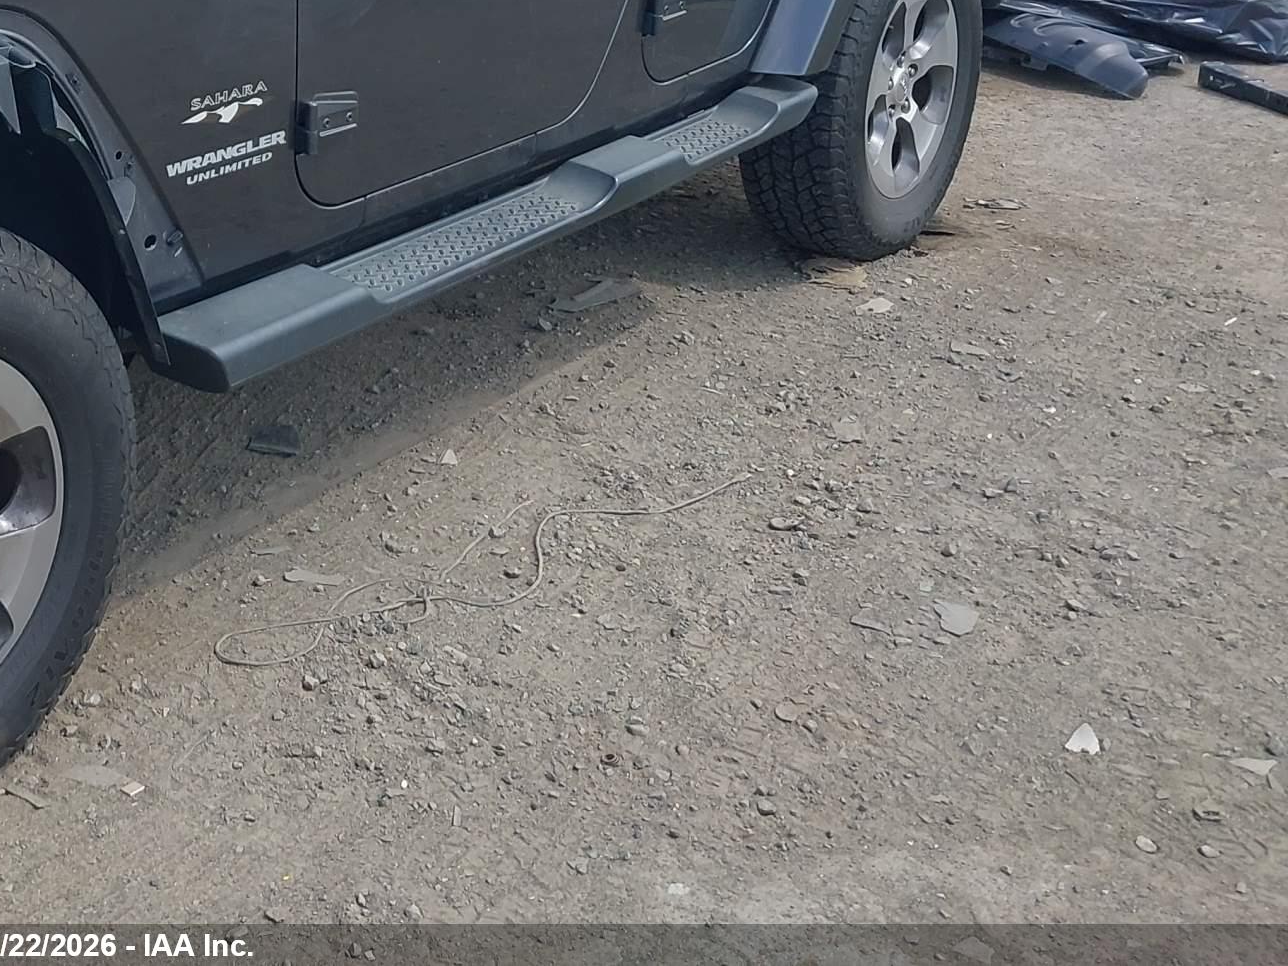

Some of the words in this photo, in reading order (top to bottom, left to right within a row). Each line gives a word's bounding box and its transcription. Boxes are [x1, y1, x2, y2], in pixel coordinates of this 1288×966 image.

[190, 80, 268, 111] SAHARA
[166, 130, 287, 178] WRANGLER
[186, 152, 273, 185] UNLIMITED
